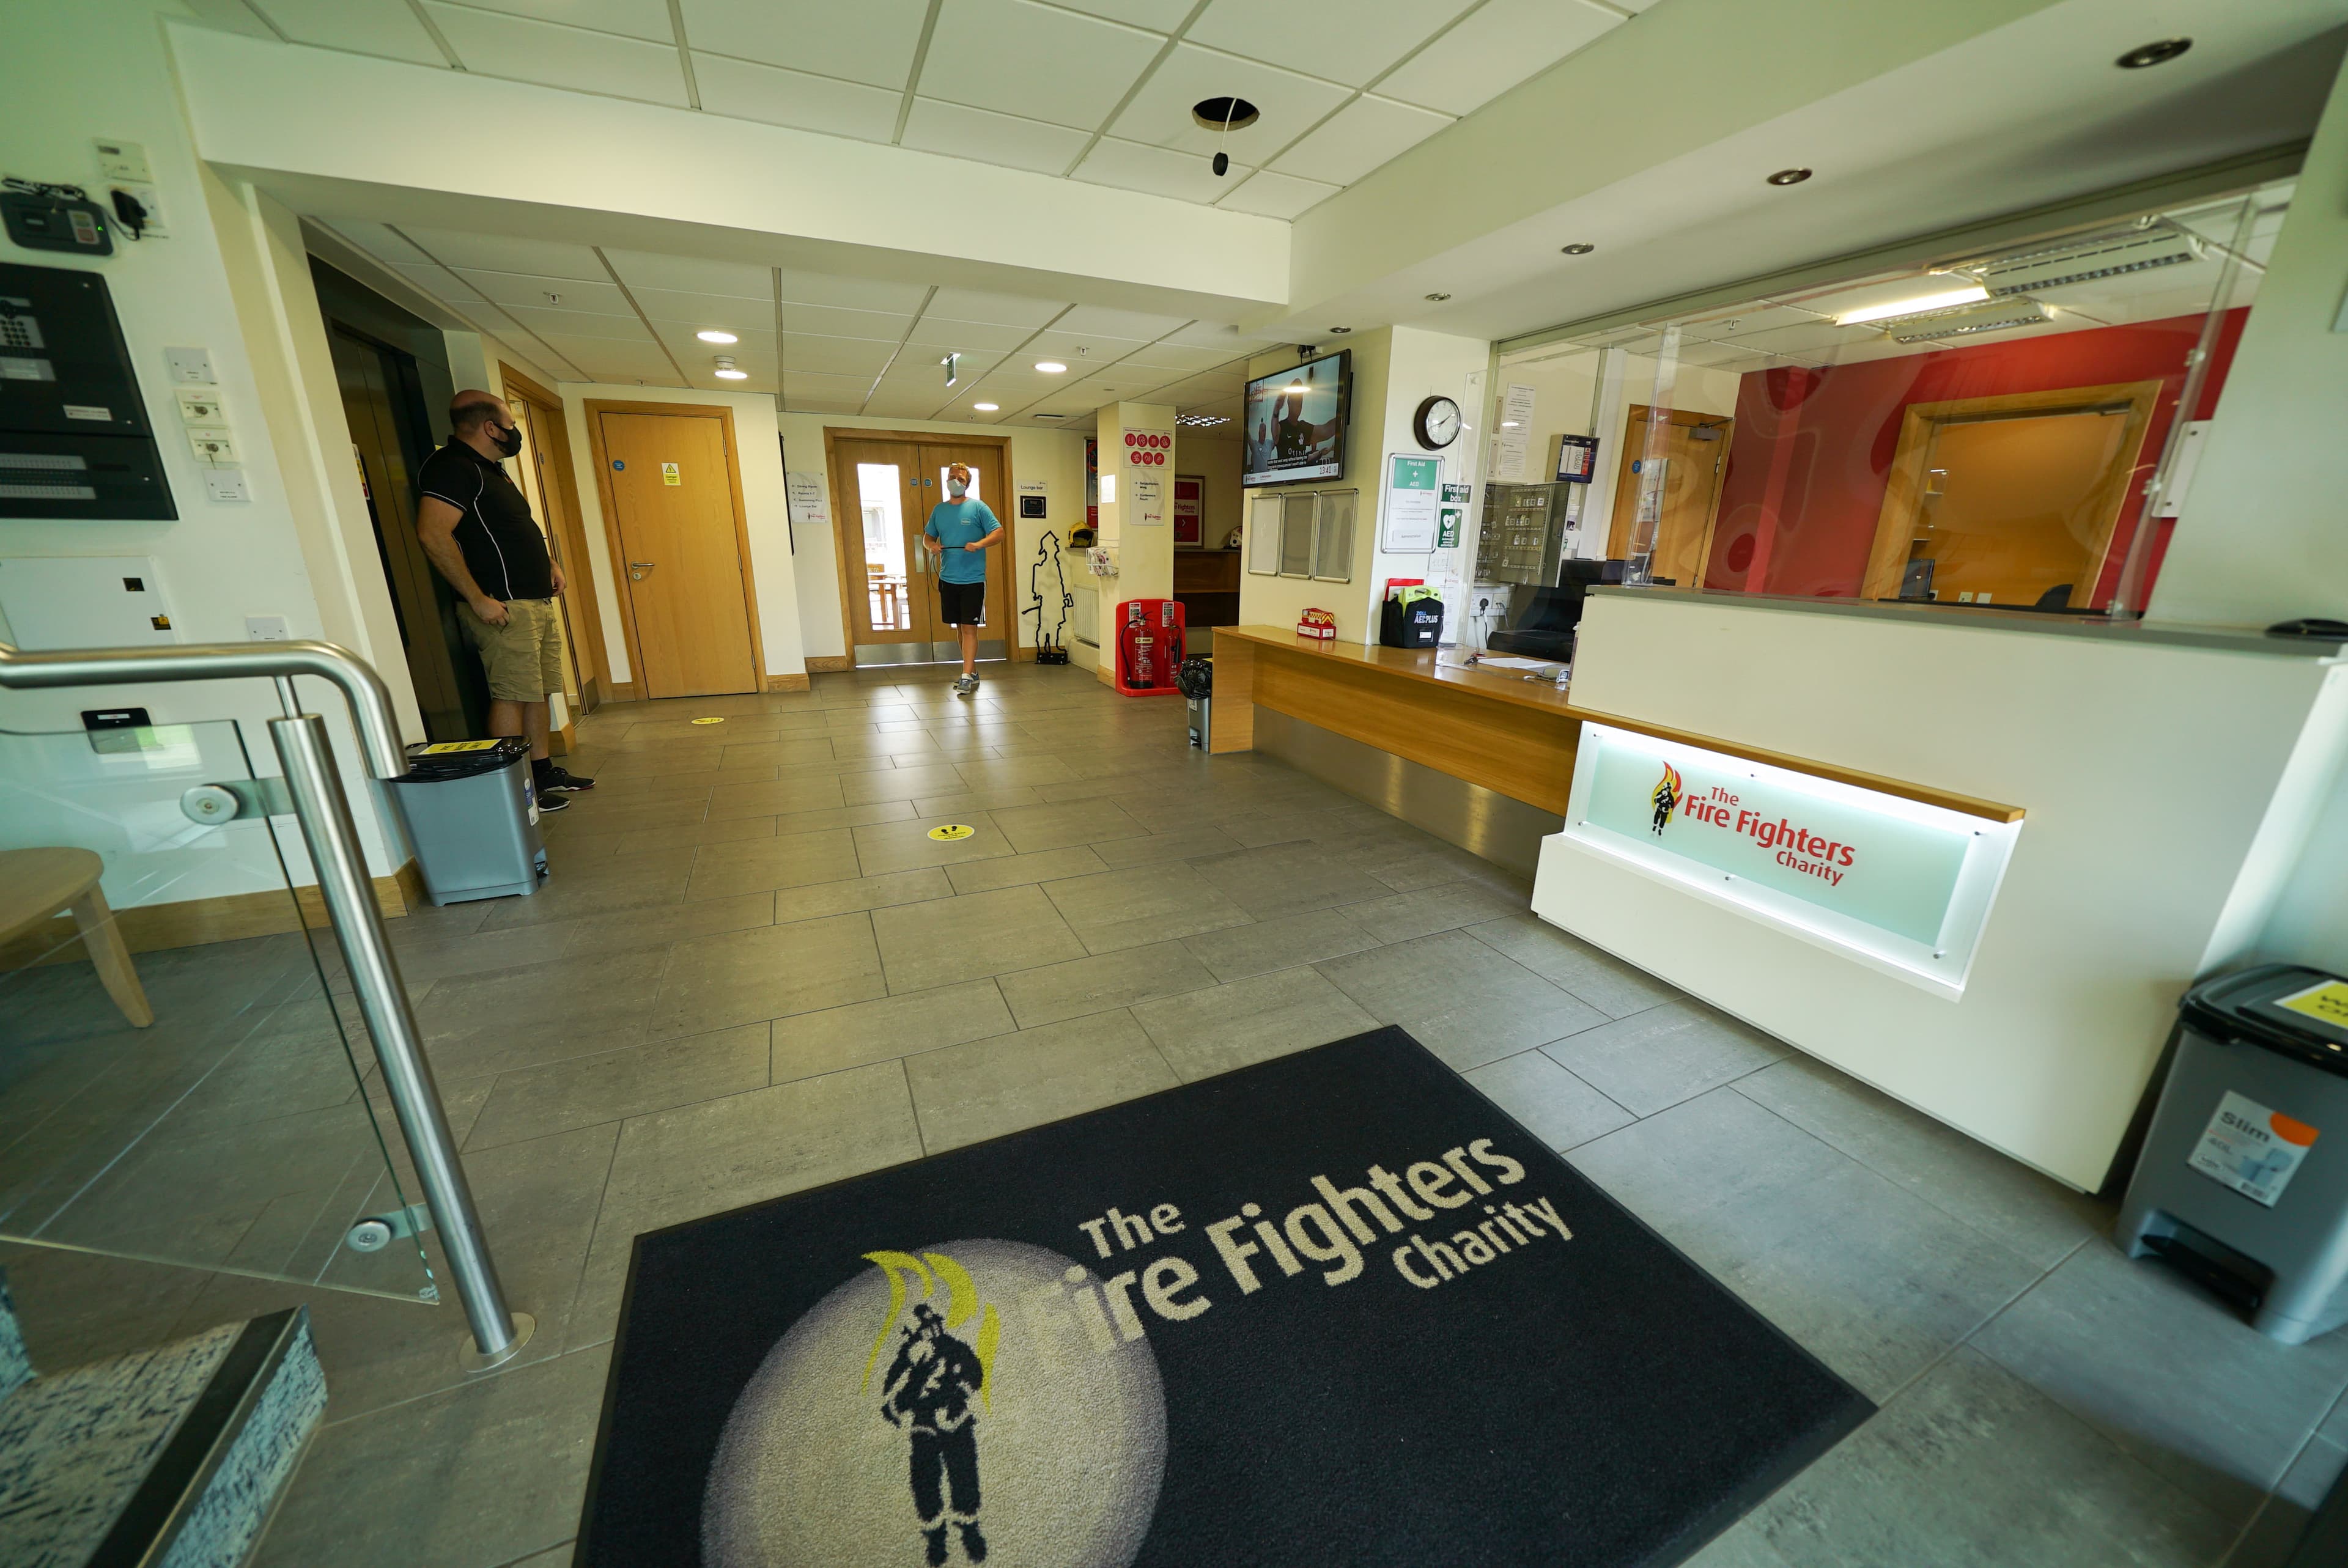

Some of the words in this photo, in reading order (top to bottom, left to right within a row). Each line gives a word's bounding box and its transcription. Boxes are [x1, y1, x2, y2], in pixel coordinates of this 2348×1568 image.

[1450, 493, 1462, 502] box
[1711, 787, 1739, 806] The
[1685, 794, 1730, 828] Fire
[1735, 809, 1856, 867] Fighters
[1776, 850, 1844, 886] Charity
[2220, 1111, 2271, 1143] Slim
[1078, 1201, 1186, 1259] The
[1392, 1194, 1574, 1291] Charity
[1023, 1256, 1212, 1377] Fire
[1205, 1136, 1526, 1296] Fighters
